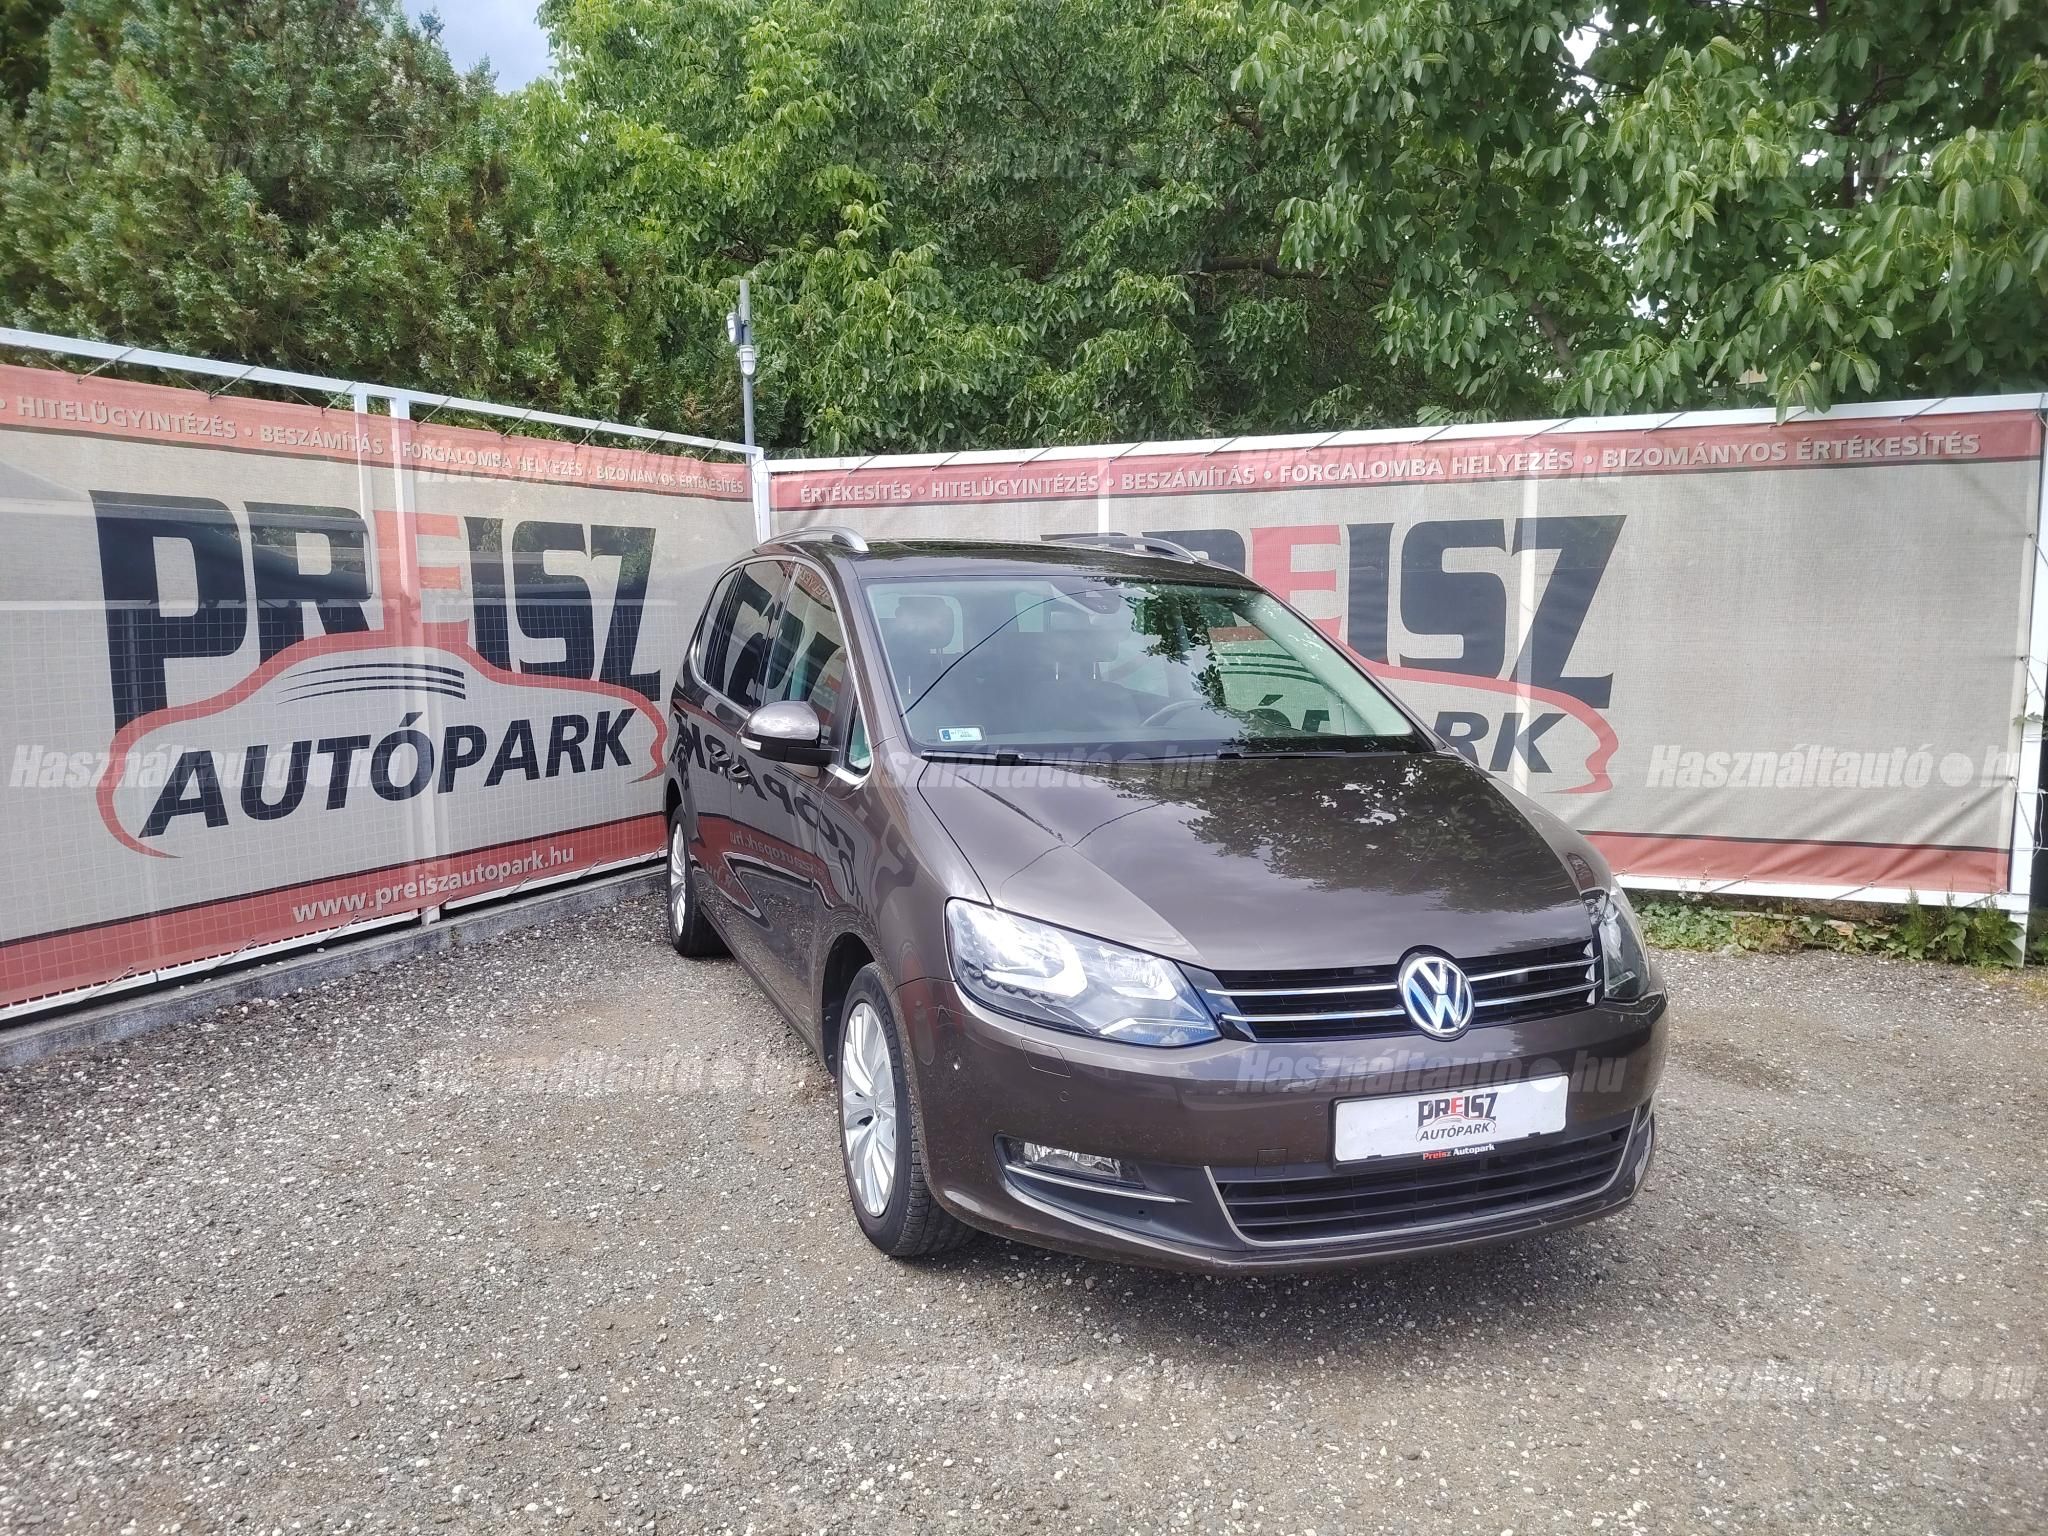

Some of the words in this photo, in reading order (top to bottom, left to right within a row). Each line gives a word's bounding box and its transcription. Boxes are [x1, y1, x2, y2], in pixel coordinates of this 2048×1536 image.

[16, 395, 237, 439] HITELÜGYINTÉZÉS
[260, 424, 384, 456] BESZÁMÍTÁS
[402, 441, 513, 469] FORGALOMBA
[518, 456, 584, 477] HELYEZÉS
[800, 480, 911, 504] ÉRTÉKESÍTÉS
[931, 473, 1099, 499] HITELÜGYINTÉZÉS
[1121, 465, 1255, 490] BESZÁMÍTÁS
[1280, 458, 1444, 483] FORGALOMBA
[1452, 449, 1574, 476] HELYEZÉS
[1602, 438, 1787, 468] BIZOMÁNYOS
[1796, 431, 1981, 461] ÉRTÉKESÍTÉS
[89, 489, 662, 735] PREISZ
[138, 709, 637, 838] AUTÓPARK
[292, 847, 574, 923] www.preiszautopark.hu
[1418, 1092, 1498, 1127] PREISZ
[1419, 1122, 1491, 1142] AUTÓPARK
[1423, 1149, 1451, 1161] Preisz
[1453, 1143, 1496, 1157] Autopark
